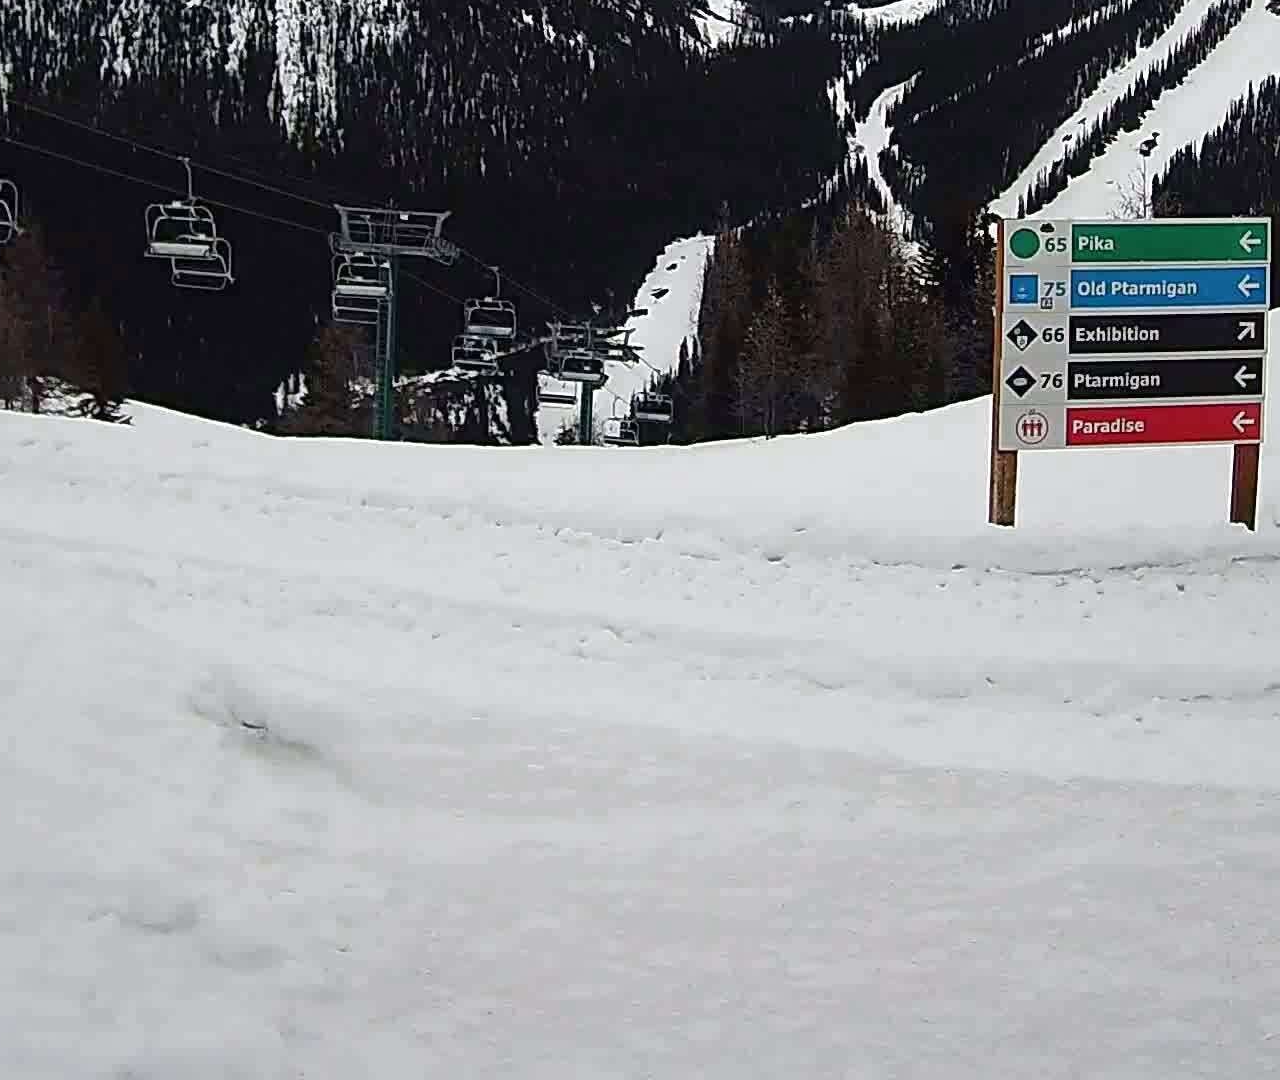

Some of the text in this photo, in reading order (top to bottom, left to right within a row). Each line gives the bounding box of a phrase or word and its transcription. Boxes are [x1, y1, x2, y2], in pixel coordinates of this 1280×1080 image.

[1044, 235, 1115, 253] 65 Pika
[1043, 280, 1197, 297] 75 Old Ptarmigan
[1042, 326, 1160, 343] 66 Exhibition
[1040, 373, 1160, 390] 76 Ptarmigan
[1072, 418, 1145, 434] Paradise
